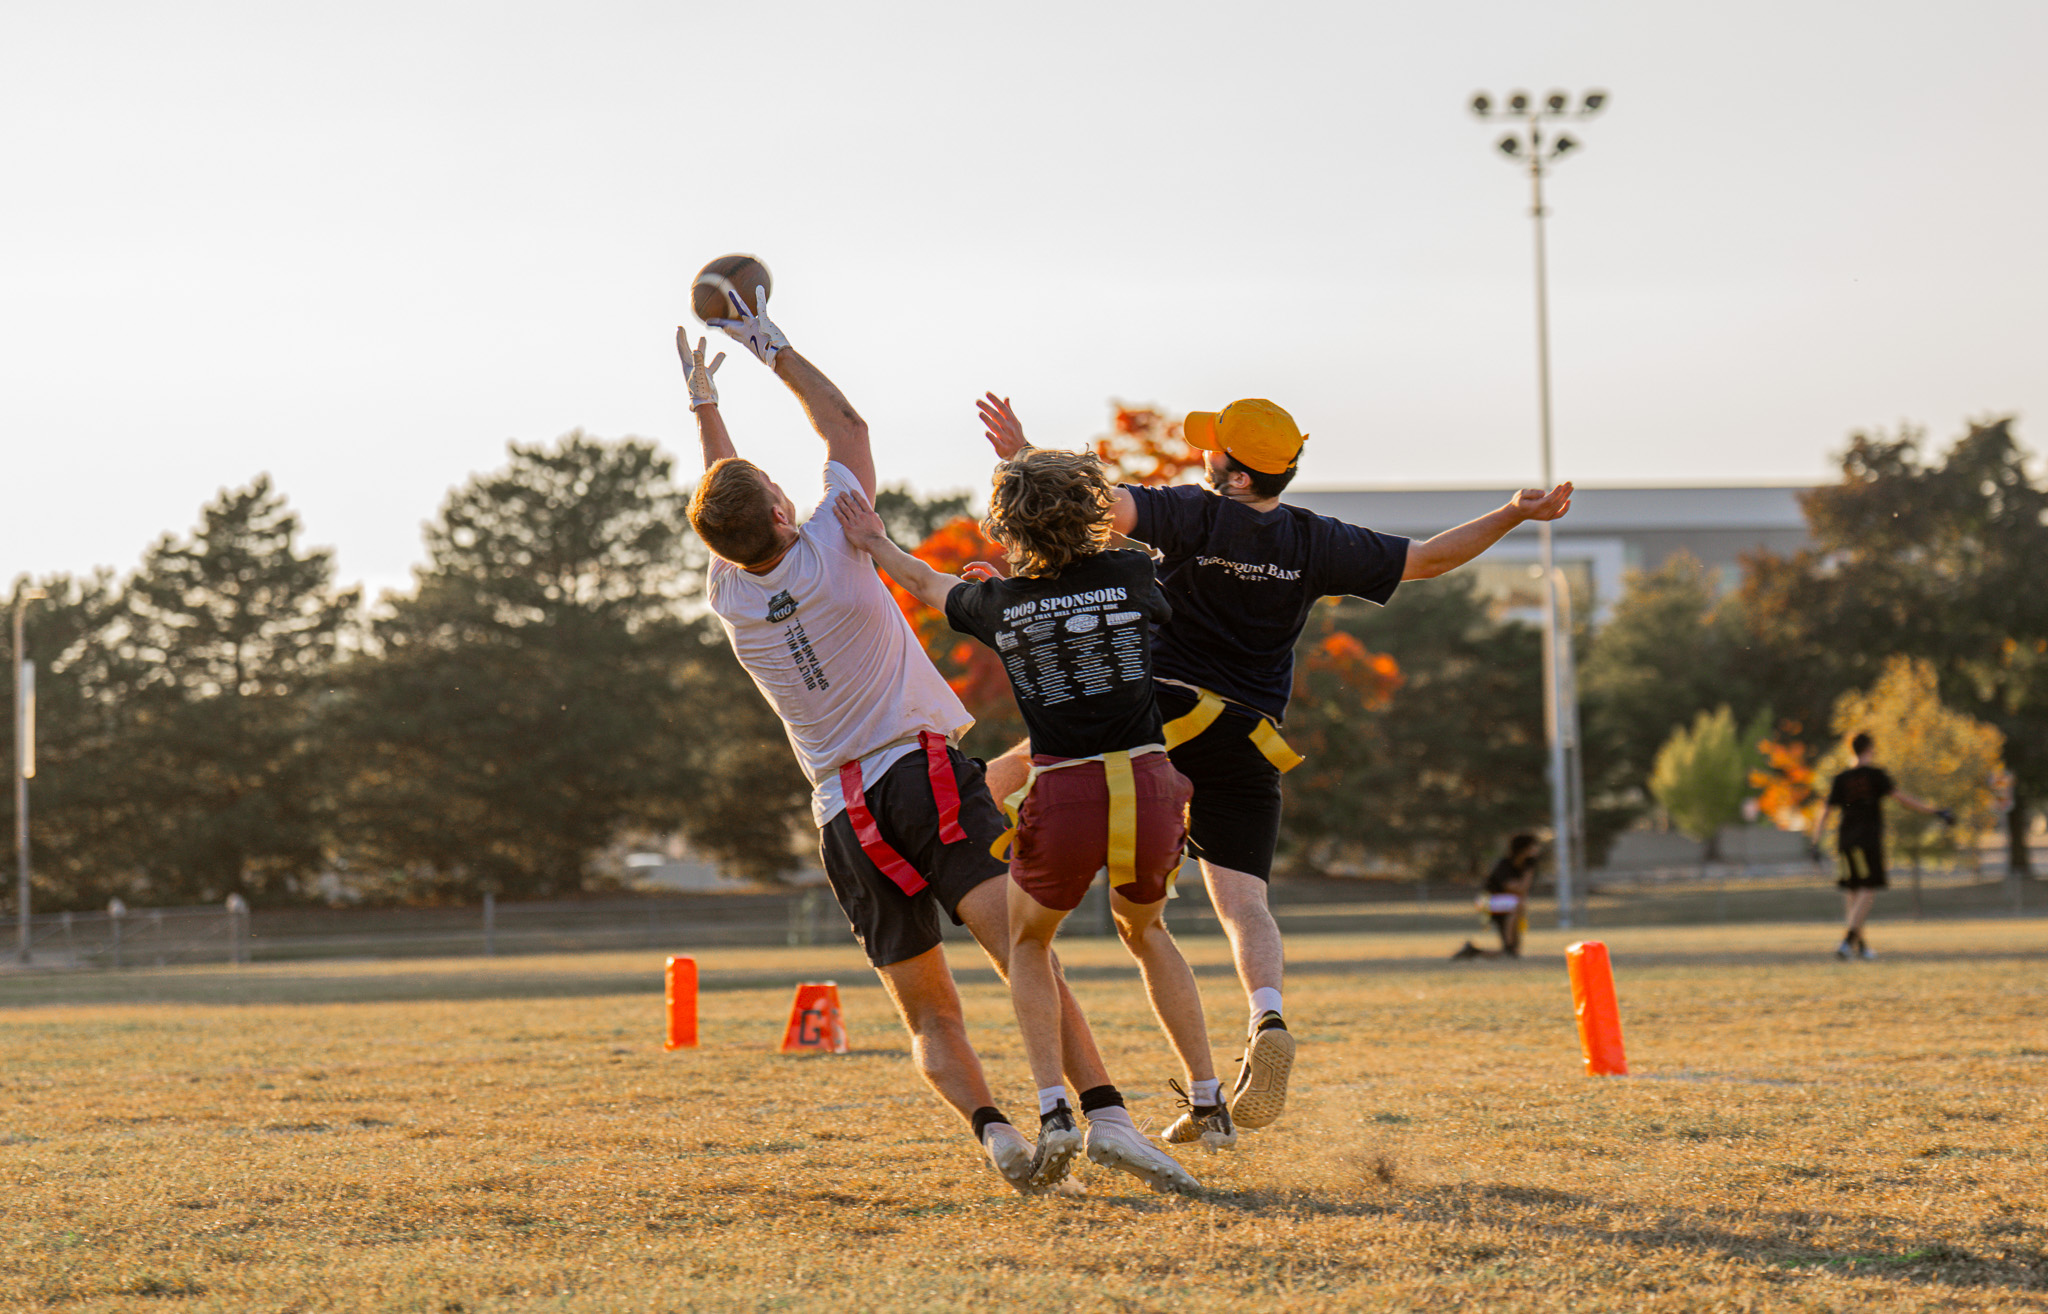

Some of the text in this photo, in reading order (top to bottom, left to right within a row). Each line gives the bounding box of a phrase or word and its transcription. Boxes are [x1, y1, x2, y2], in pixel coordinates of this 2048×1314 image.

[1002, 586, 1128, 622] 2009 SPONSORS
[1010, 603, 1119, 628] HOTTER THAN HELL CHARITY RIDE
[791, 650, 805, 665] ON
[801, 644, 830, 692] SPARTANS
[798, 664, 818, 692] BUILT
[799, 1009, 822, 1045] G
